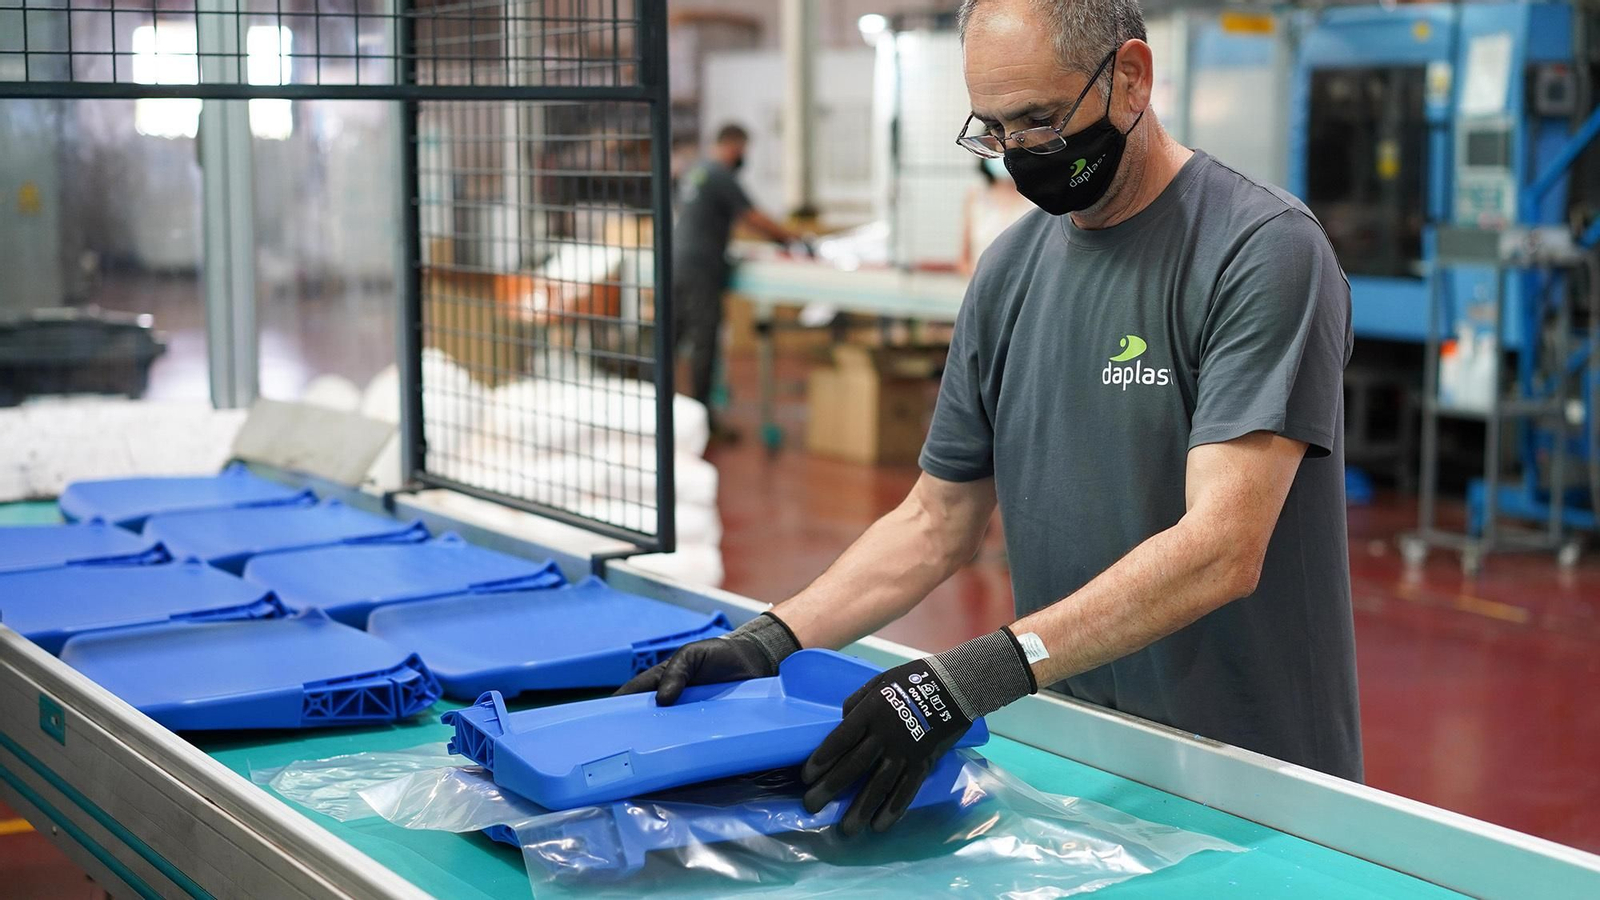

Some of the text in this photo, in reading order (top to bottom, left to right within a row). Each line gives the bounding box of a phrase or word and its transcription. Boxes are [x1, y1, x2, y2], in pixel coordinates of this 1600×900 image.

[1102, 360, 1173, 391] daplas
[881, 686, 925, 742] ECOPU
[908, 687, 933, 717] PU1400
